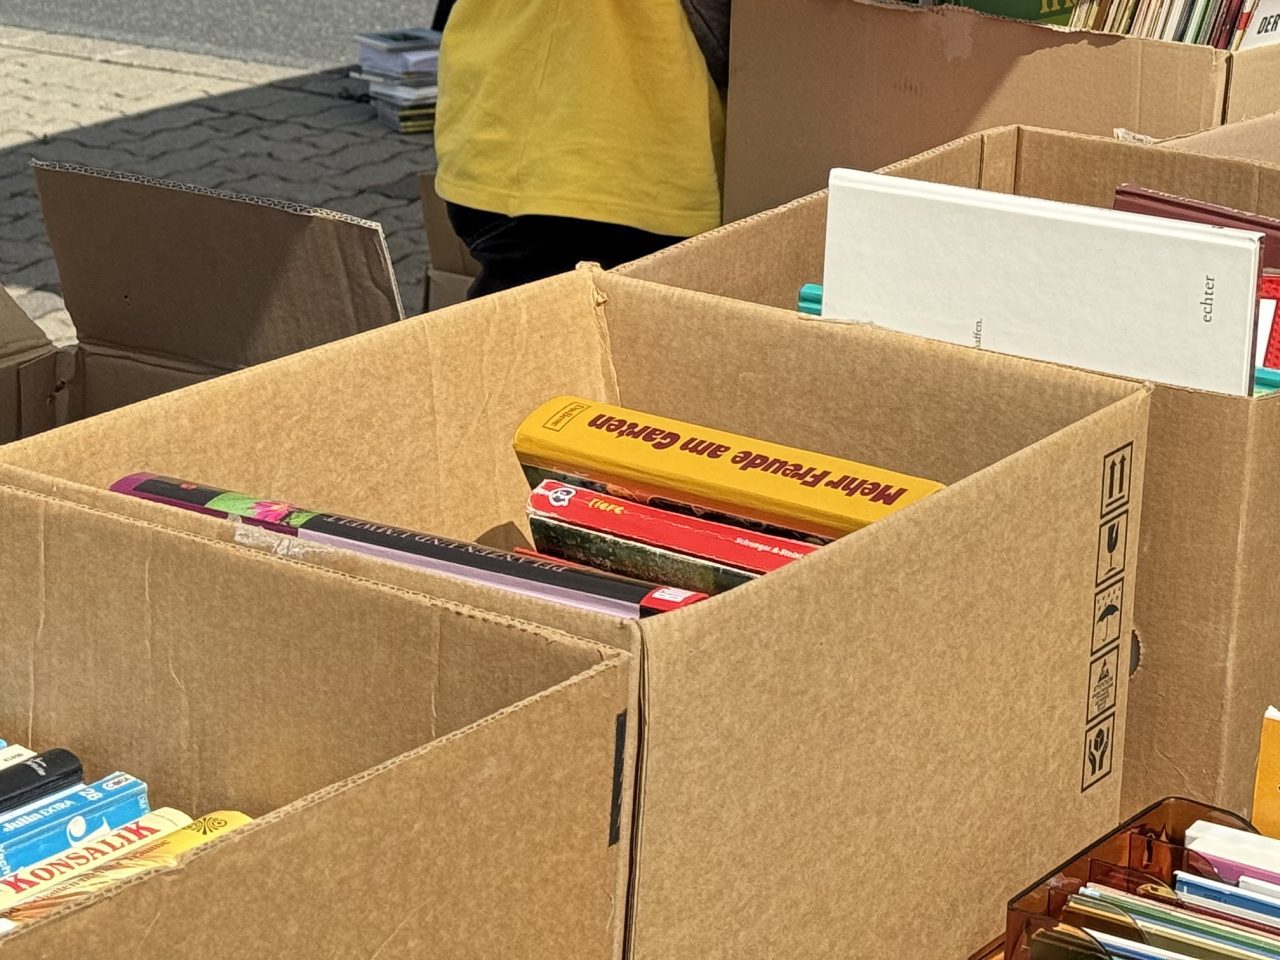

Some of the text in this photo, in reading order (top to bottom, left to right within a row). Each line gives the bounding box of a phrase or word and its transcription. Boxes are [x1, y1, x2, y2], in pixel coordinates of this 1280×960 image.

[1257, 15, 1278, 35] DER
[1200, 274, 1216, 324] echter
[587, 413, 909, 506] Mehr Freude am Garten
[587, 498, 625, 516] Tiere
[321, 511, 566, 576] PFLANZEN UND UMWELT
[3, 798, 76, 833] Julia EXTRA
[2, 820, 160, 894] KONSALIK
